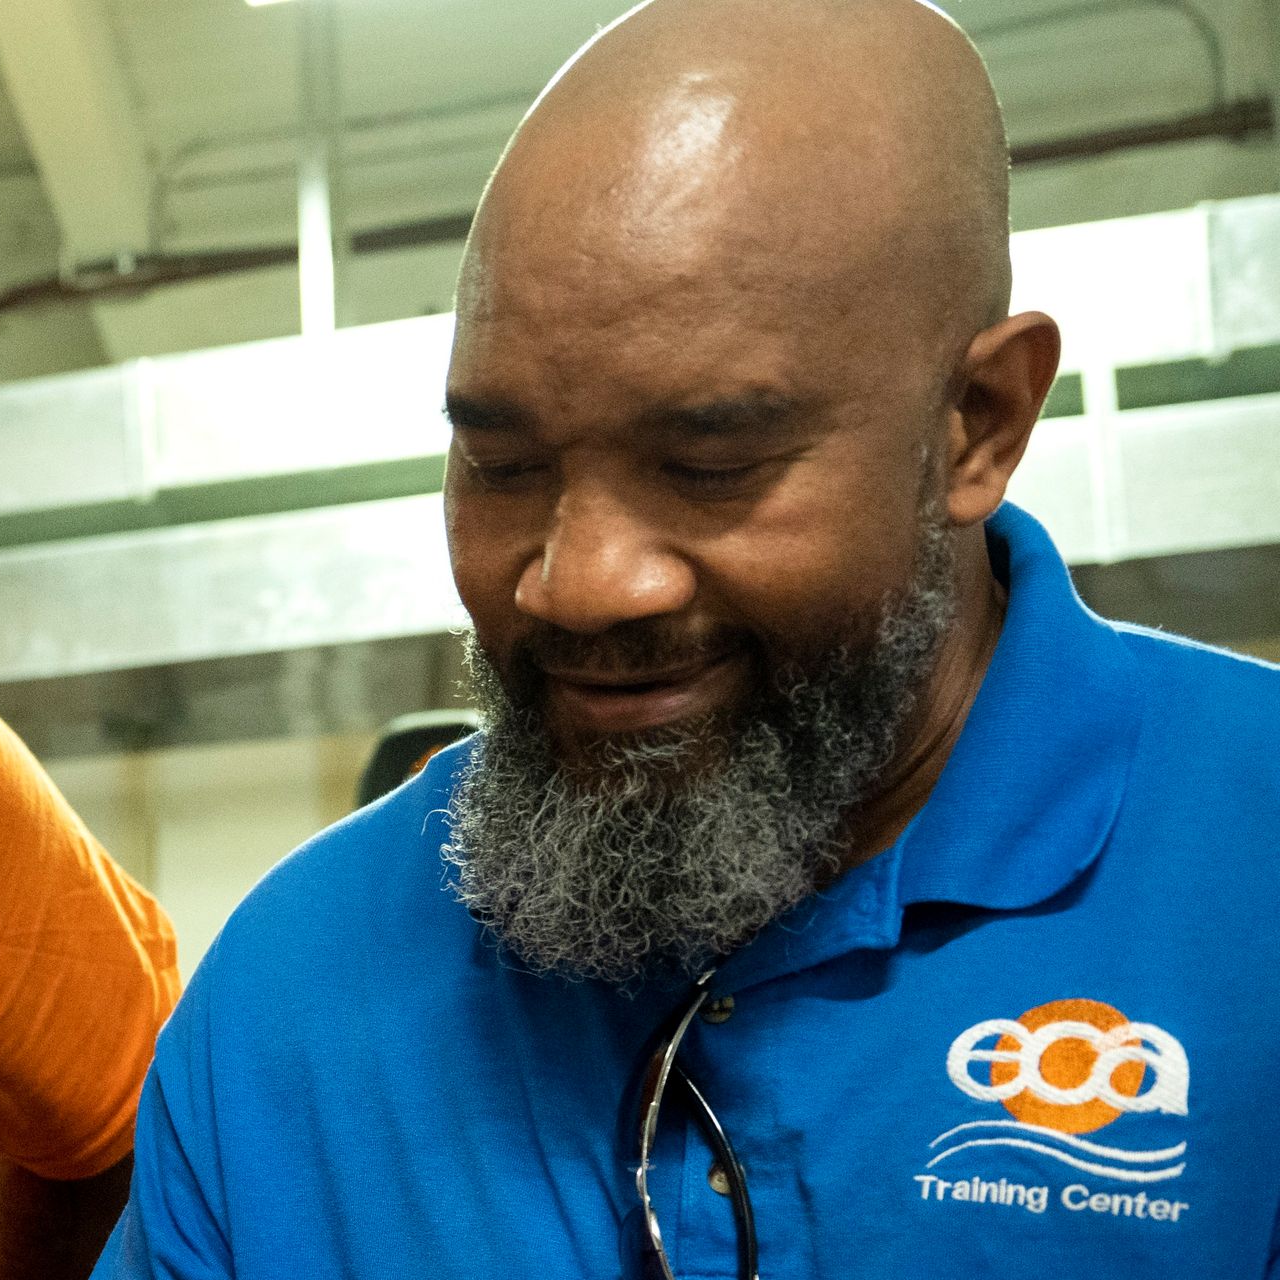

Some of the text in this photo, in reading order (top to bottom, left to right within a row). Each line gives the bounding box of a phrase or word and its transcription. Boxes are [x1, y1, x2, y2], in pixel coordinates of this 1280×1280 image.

[946, 1018, 1190, 1117] eca
[912, 1174, 1190, 1222] Training Center
